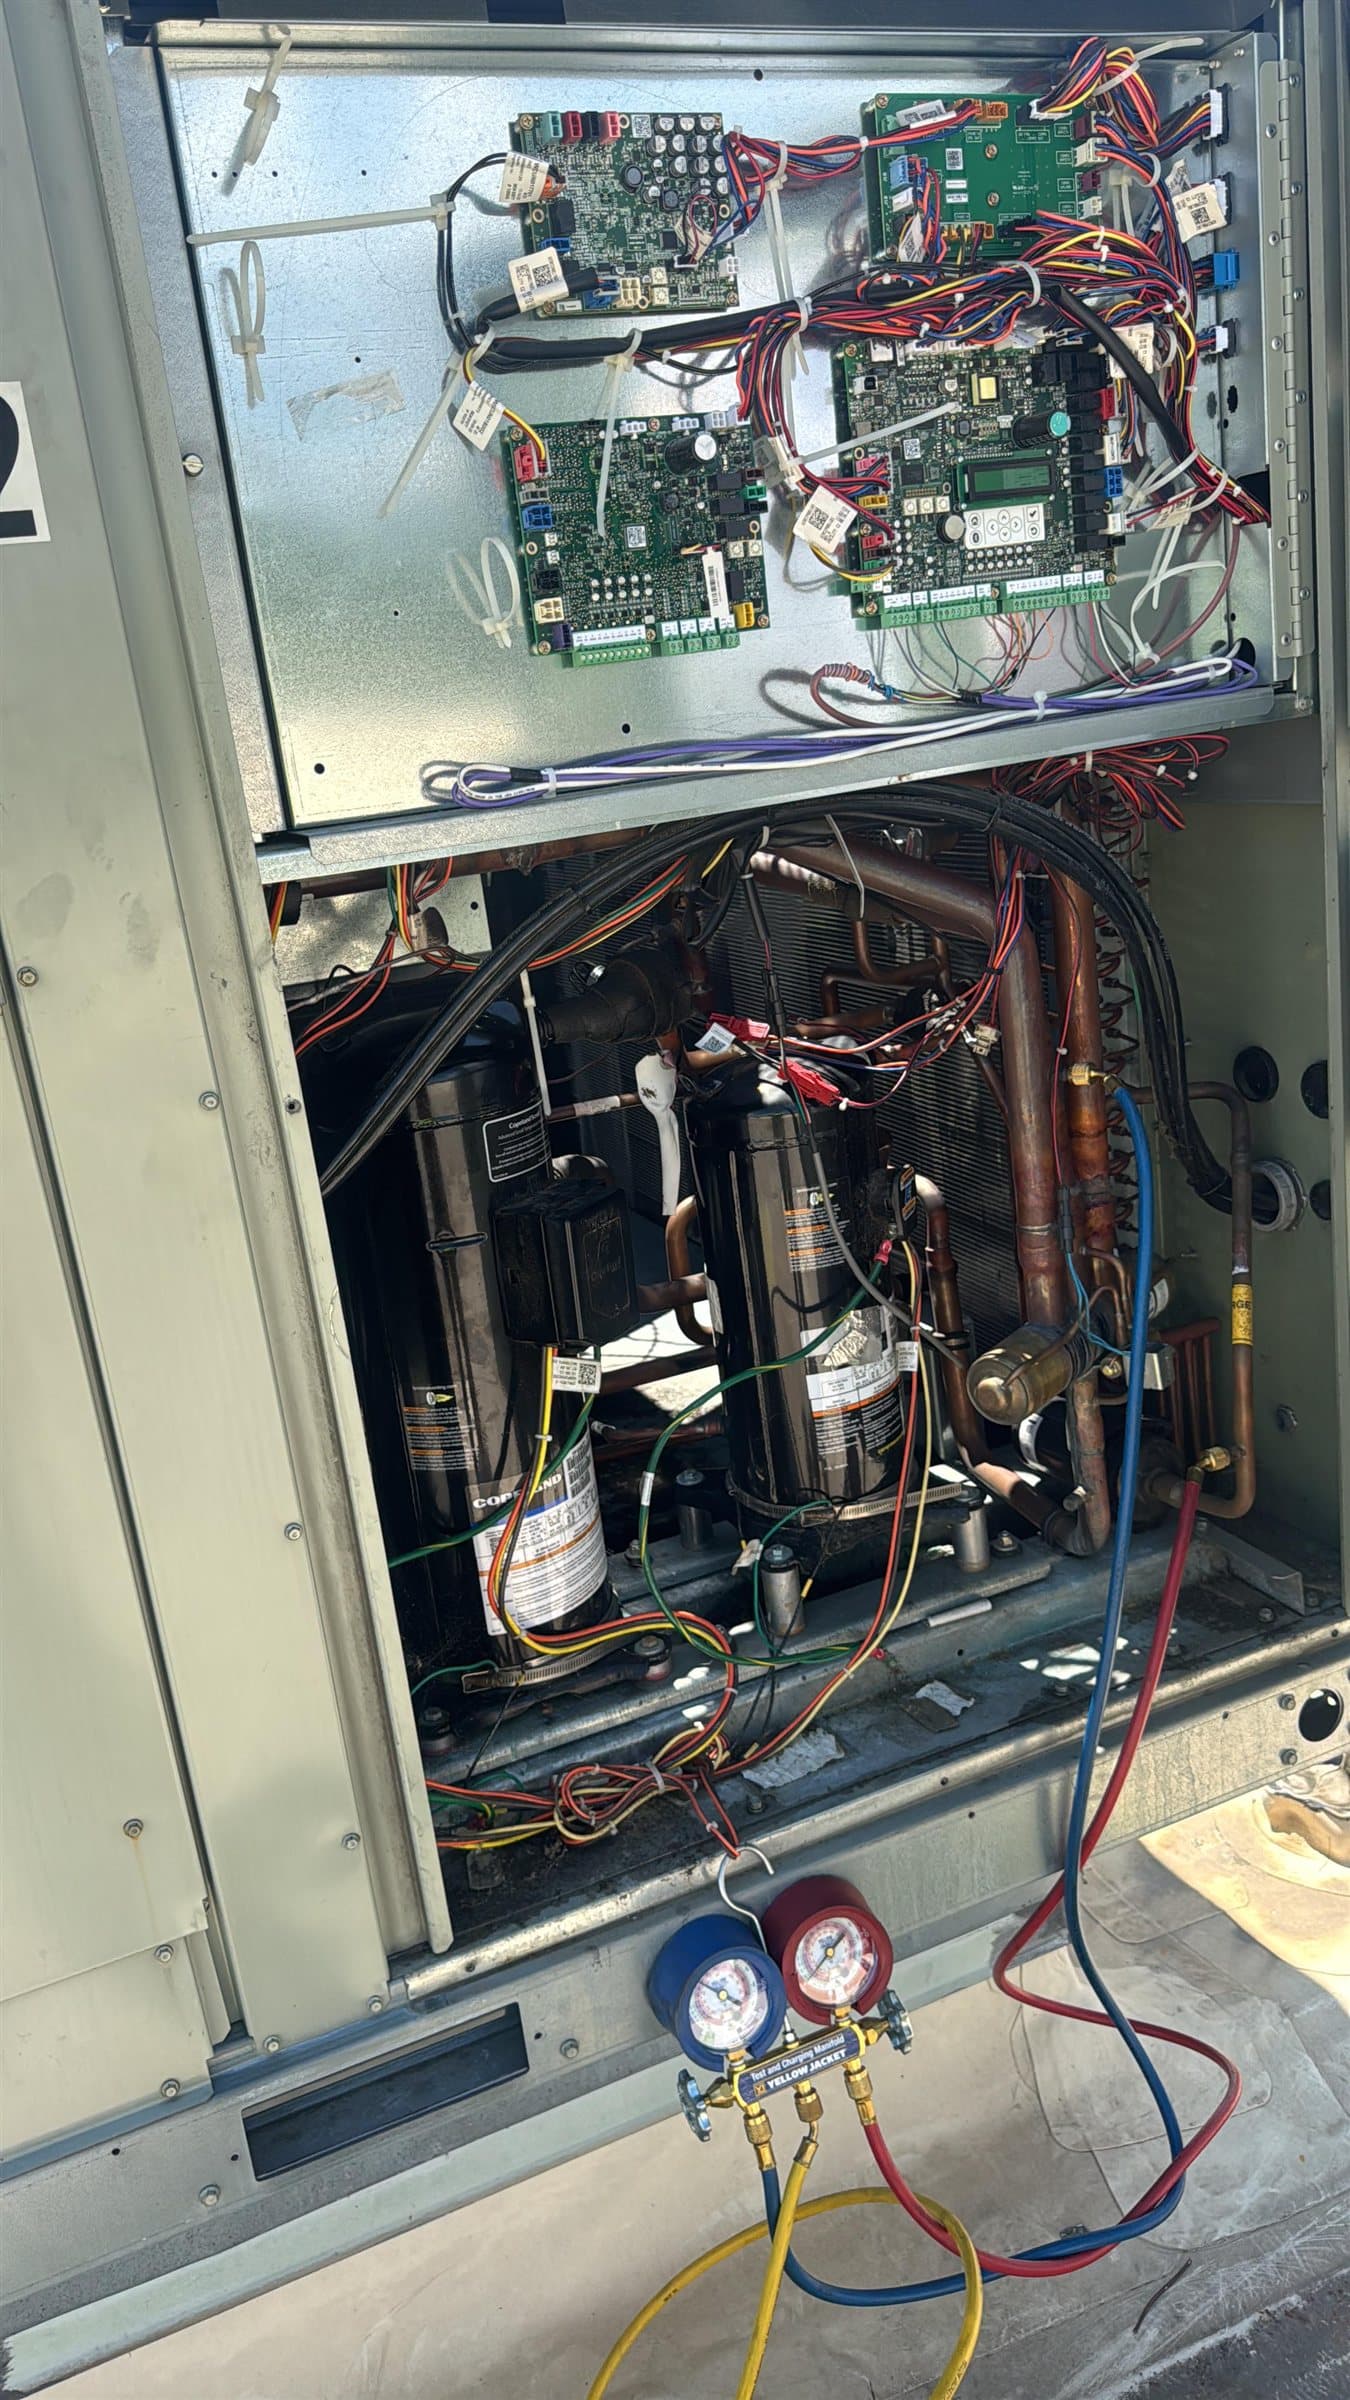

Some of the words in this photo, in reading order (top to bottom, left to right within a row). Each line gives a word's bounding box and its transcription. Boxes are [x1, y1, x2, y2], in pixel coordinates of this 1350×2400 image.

[472, 1474, 562, 1509] COPEAND
[750, 2068, 766, 2082] Test
[768, 2062, 782, 2075] and
[782, 2050, 815, 2067] Charging
[814, 2034, 845, 2055] Manifold
[767, 2066, 809, 2089] YELLOW
[809, 2050, 847, 2072] JACKET
